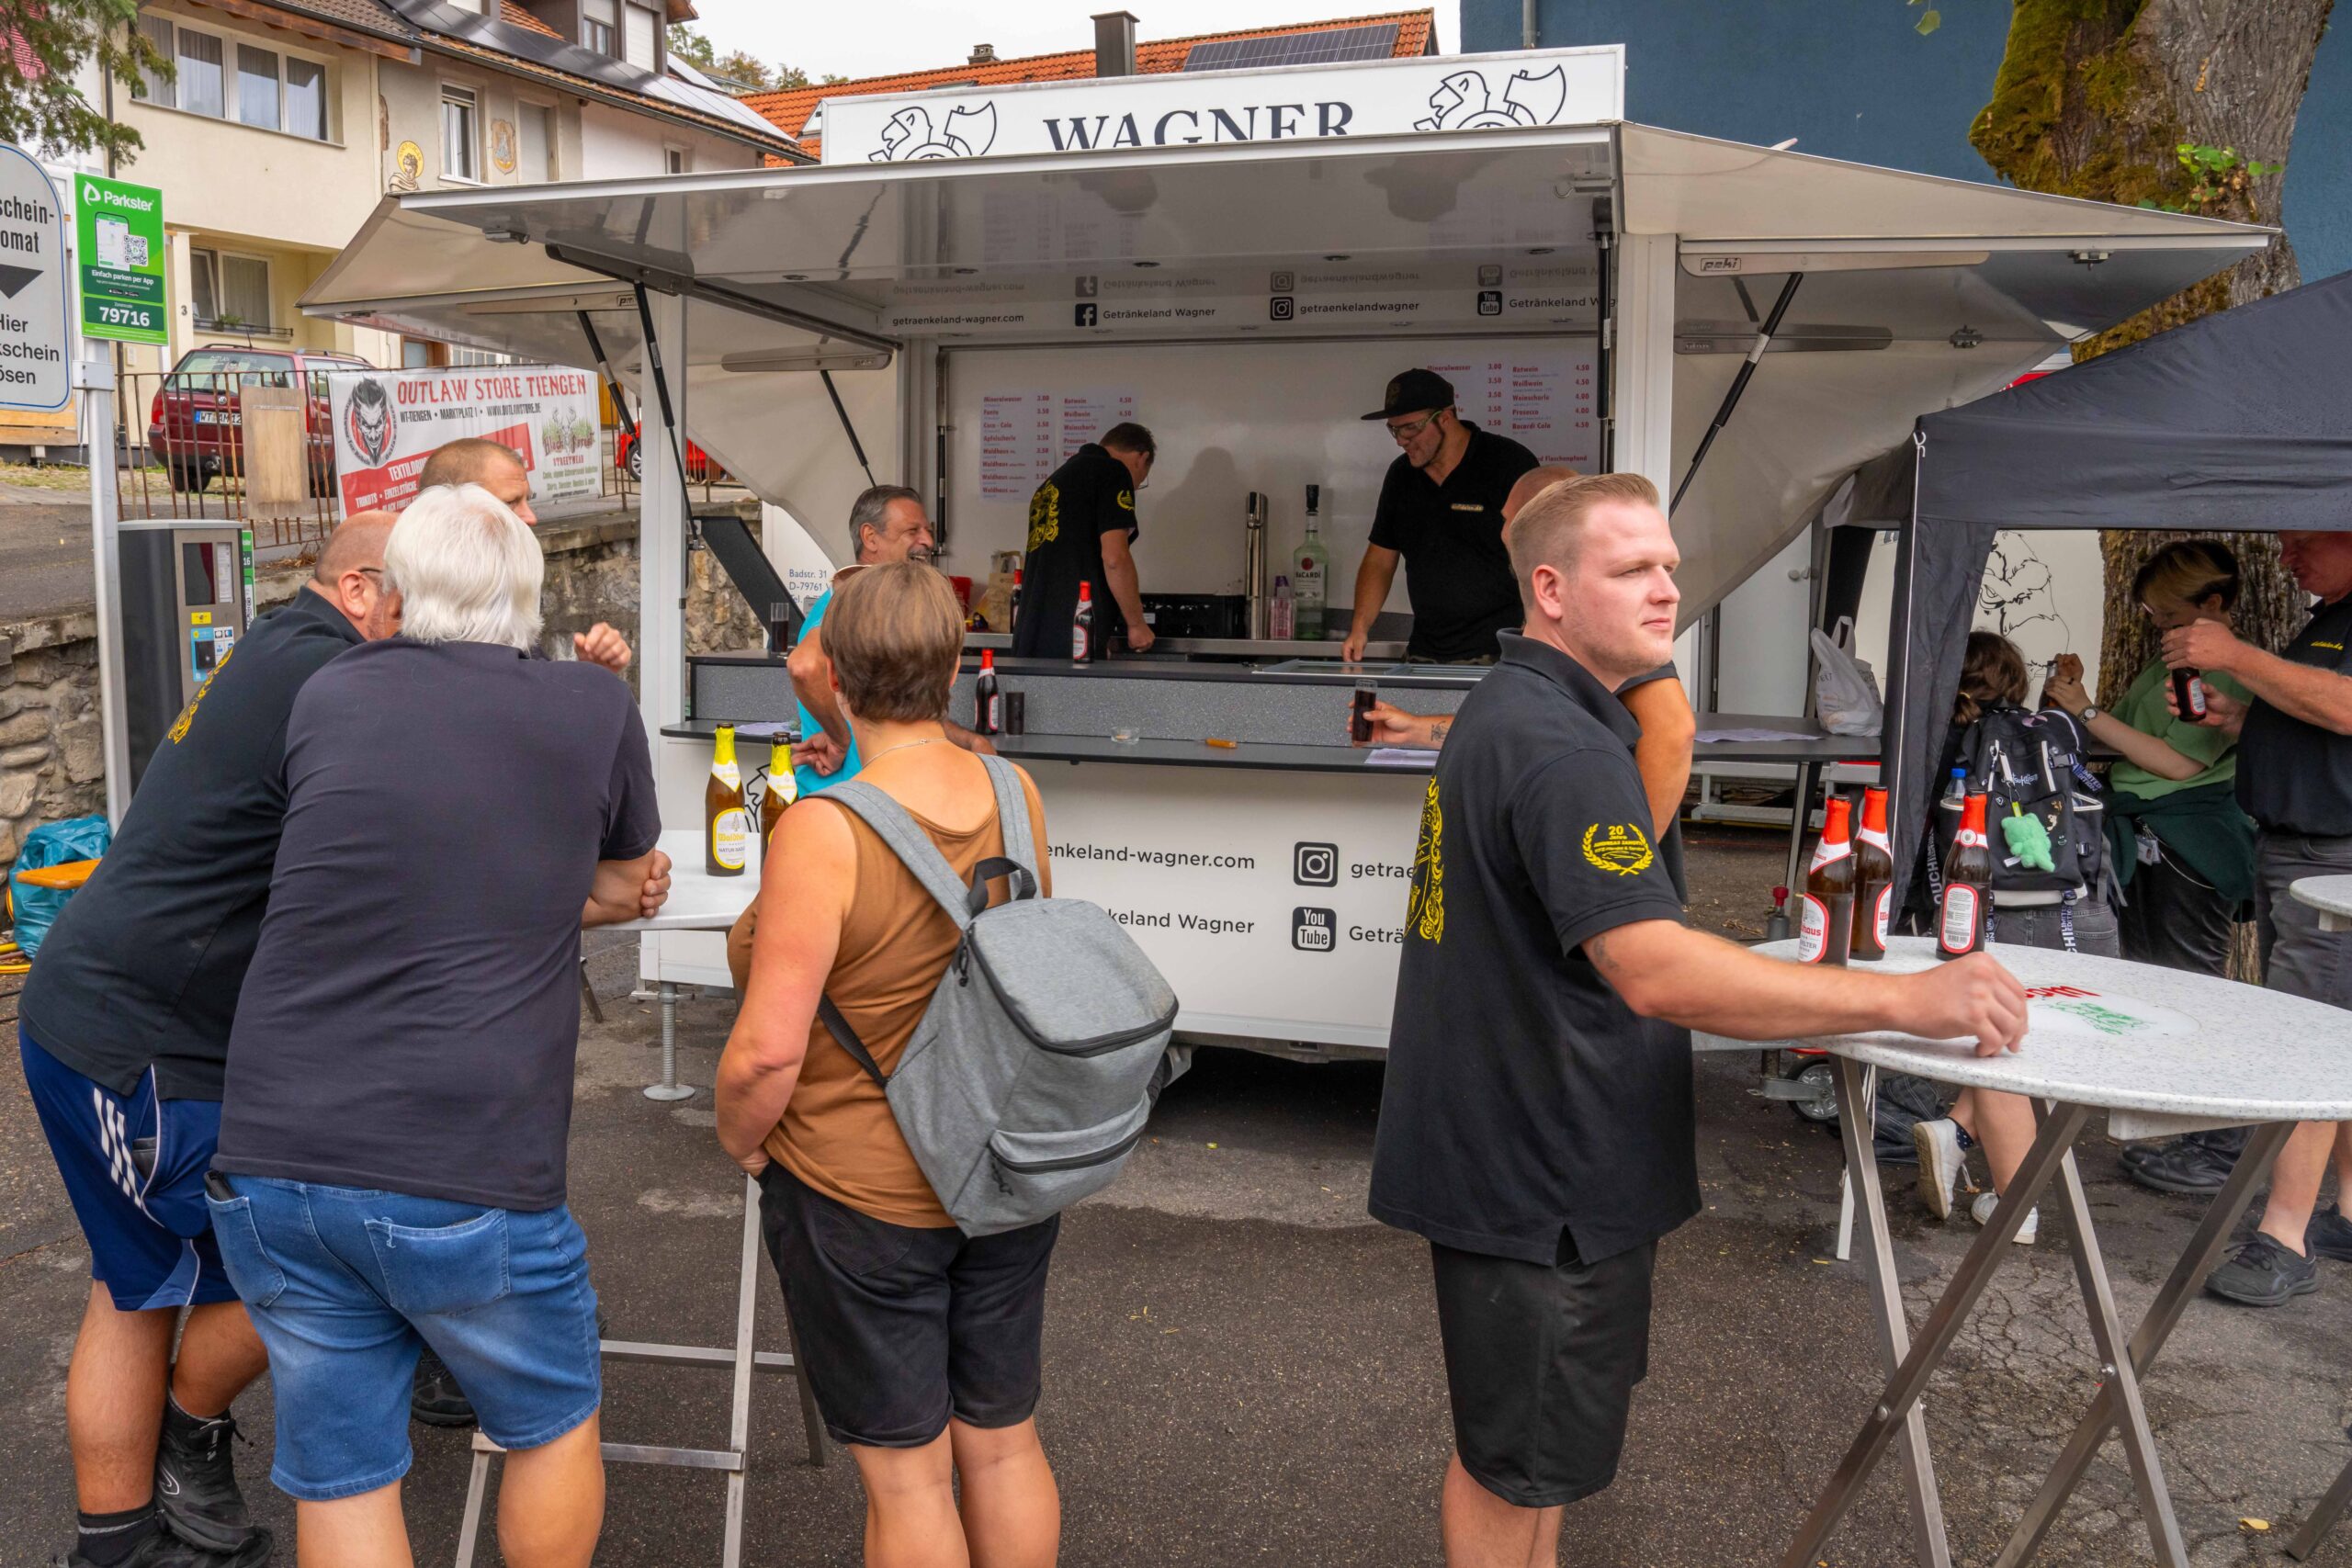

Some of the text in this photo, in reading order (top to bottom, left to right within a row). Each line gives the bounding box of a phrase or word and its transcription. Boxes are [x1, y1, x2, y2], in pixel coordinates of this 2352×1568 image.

[1043, 102, 1353, 151] WAGNER
[104, 190, 153, 212] Parkster
[92, 269, 112, 278] Einfach
[113, 273, 131, 283] parken
[132, 276, 141, 284] per
[143, 277, 154, 287] App
[1483, 292, 1497, 301] You
[1509, 296, 1587, 309] Getränkeland
[181, 304, 187, 316] 3
[1102, 307, 1216, 320] Getränkeland Wagner
[1300, 300, 1419, 314] getraenkelandwagner
[1481, 302, 1498, 313] Tube
[99, 306, 150, 327] 79716
[892, 313, 1024, 327] getraenkeland-wagner.com
[0, 342, 60, 362] schein
[397, 375, 587, 405] OUTLAW STORE TIENGEN
[200, 412, 212, 423] WT
[400, 410, 433, 423] WT-TIENGEN
[439, 407, 474, 420] MARKTPLATZ
[789, 569, 827, 578] Badstr. 31
[789, 581, 822, 591] D-79761
[1608, 825, 1624, 836] 20
[1178, 913, 1255, 934] Wagner
[1303, 908, 1325, 925] You
[1300, 929, 1328, 945] Tube
